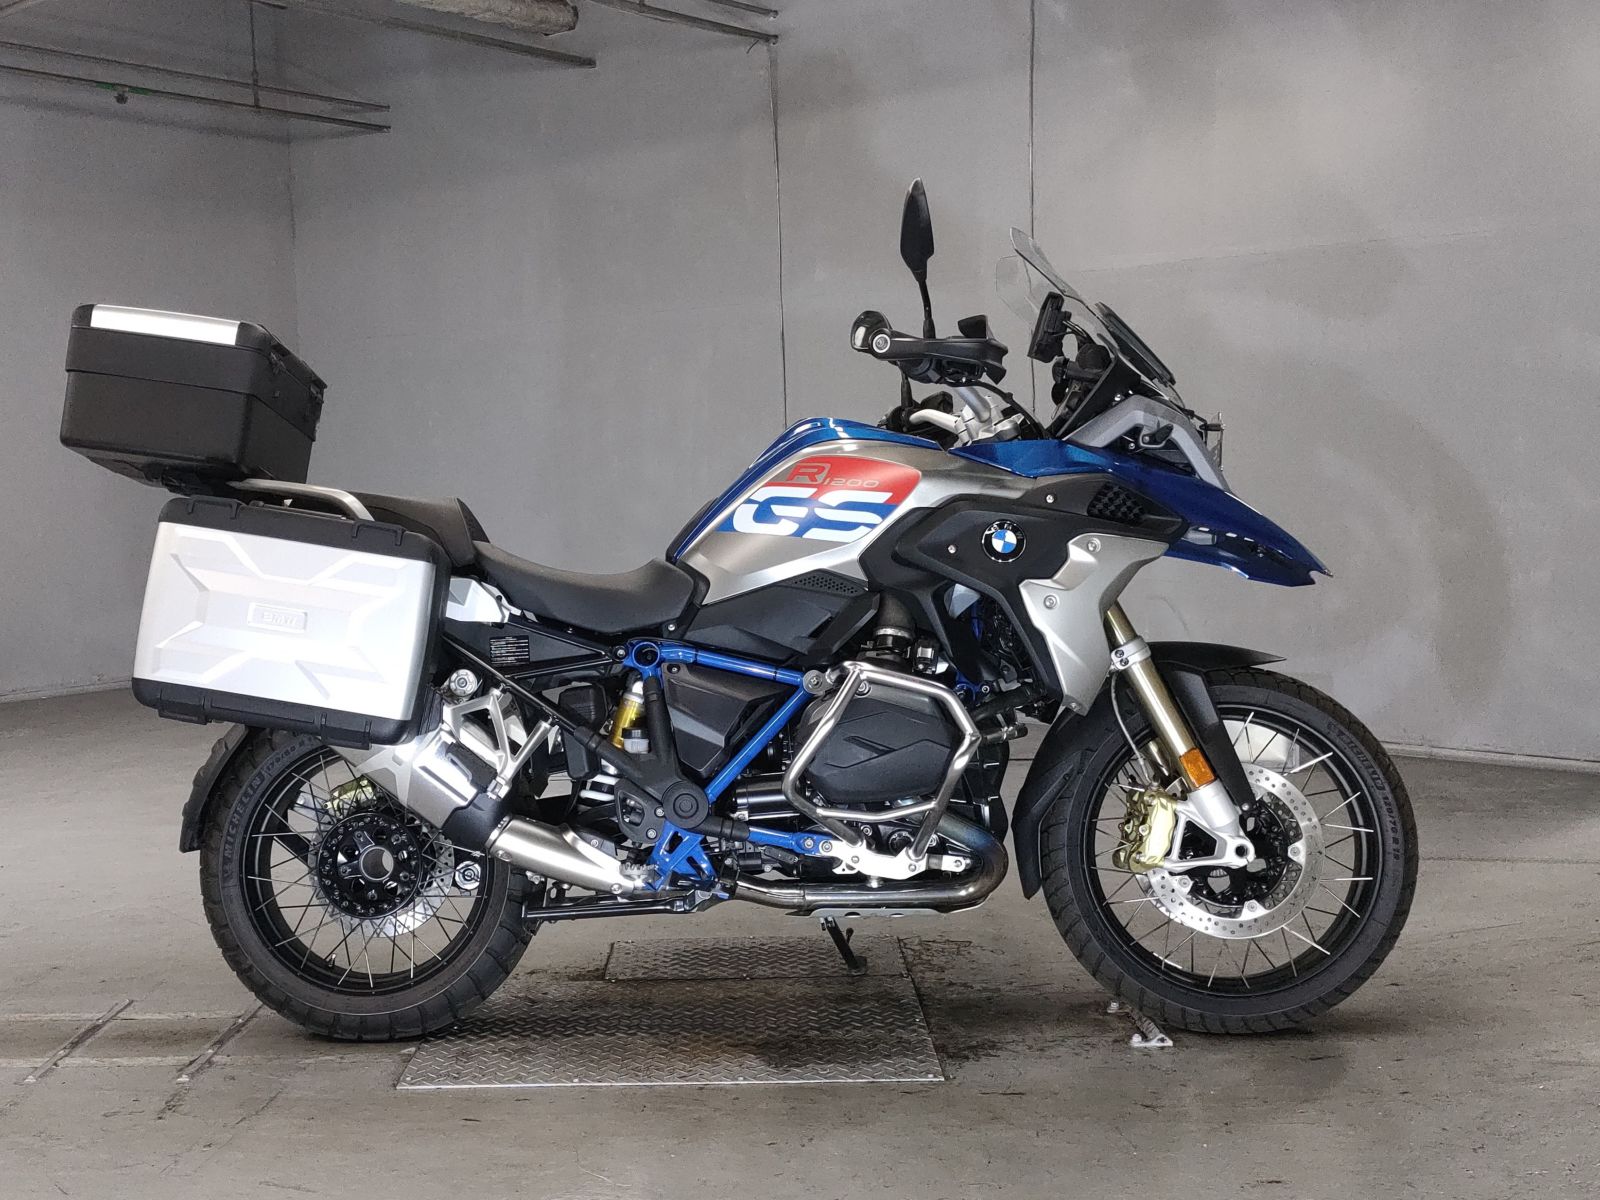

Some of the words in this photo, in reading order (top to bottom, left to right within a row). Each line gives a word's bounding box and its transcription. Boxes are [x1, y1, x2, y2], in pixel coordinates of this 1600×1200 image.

[786, 463, 829, 484] R
[824, 477, 880, 488] 1200
[733, 486, 893, 543] GS
[223, 775, 264, 859] MICHELIN
